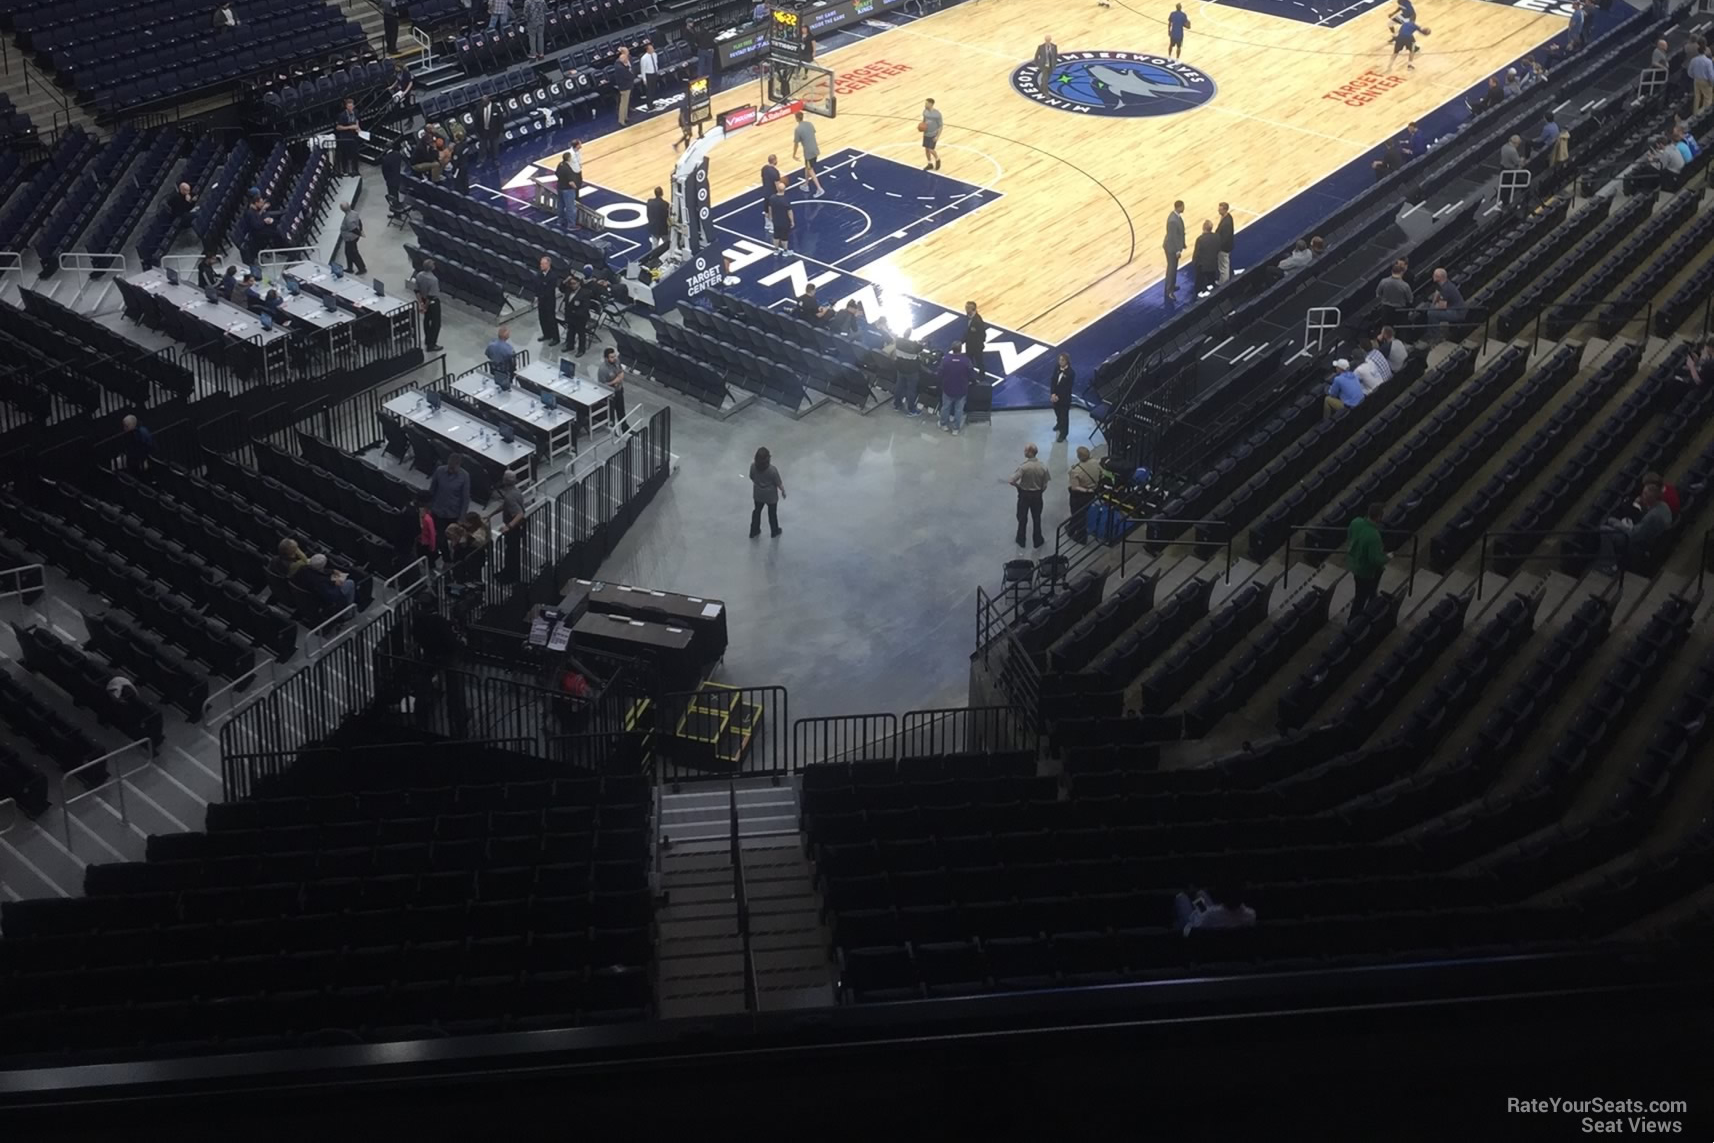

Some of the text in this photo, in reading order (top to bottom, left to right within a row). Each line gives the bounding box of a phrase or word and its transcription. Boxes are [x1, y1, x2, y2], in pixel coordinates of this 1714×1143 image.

[815, 59, 892, 88] TARGET
[835, 63, 913, 95] CENTER
[1322, 70, 1384, 102] TARGET
[463, 74, 588, 124] G G G G G G G
[1344, 75, 1407, 107] CENTER
[505, 130, 514, 140] G
[520, 125, 528, 135] G
[534, 120, 542, 130] G
[686, 264, 721, 288] TARGET
[687, 273, 723, 297] CENTER
